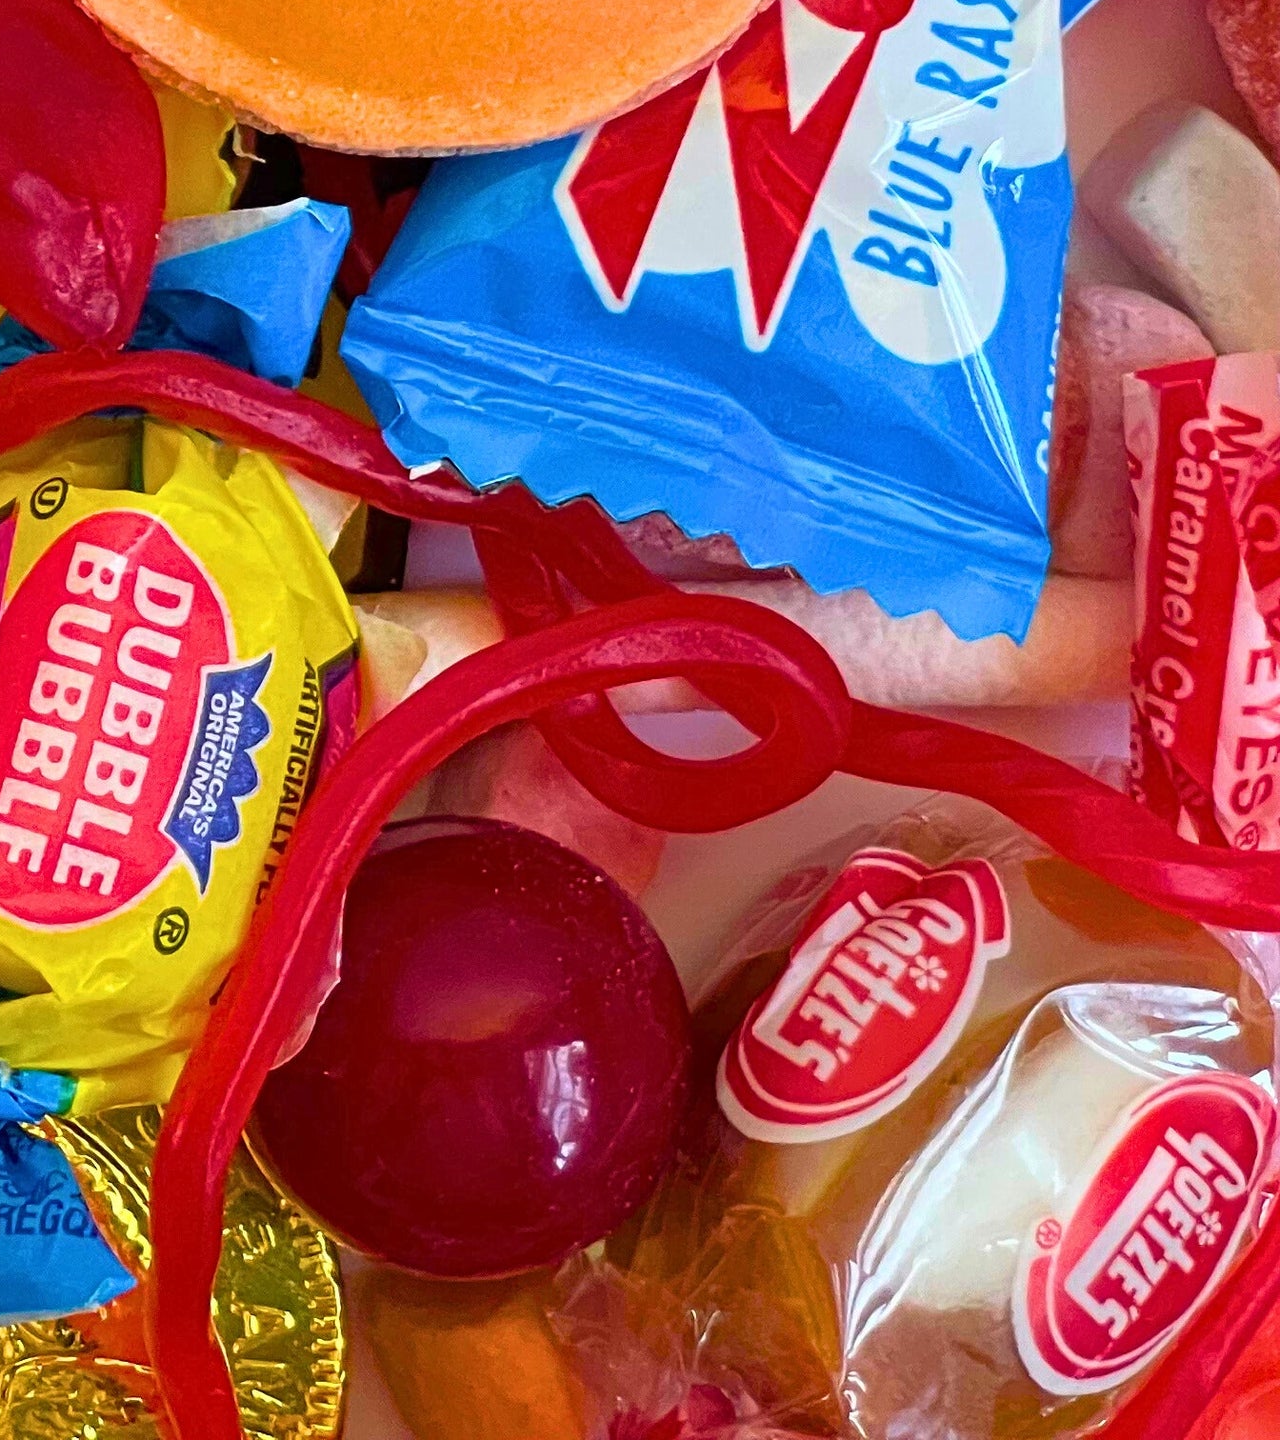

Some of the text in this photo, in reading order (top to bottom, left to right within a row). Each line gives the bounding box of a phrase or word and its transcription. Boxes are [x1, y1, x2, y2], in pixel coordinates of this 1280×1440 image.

[855, 122, 970, 285] BLUE
[1144, 417, 1212, 750] Caramel Cre
[53, 565, 195, 897] DUBBLE
[179, 693, 227, 822] ORIGINAL
[194, 690, 245, 837] AMERICA'S
